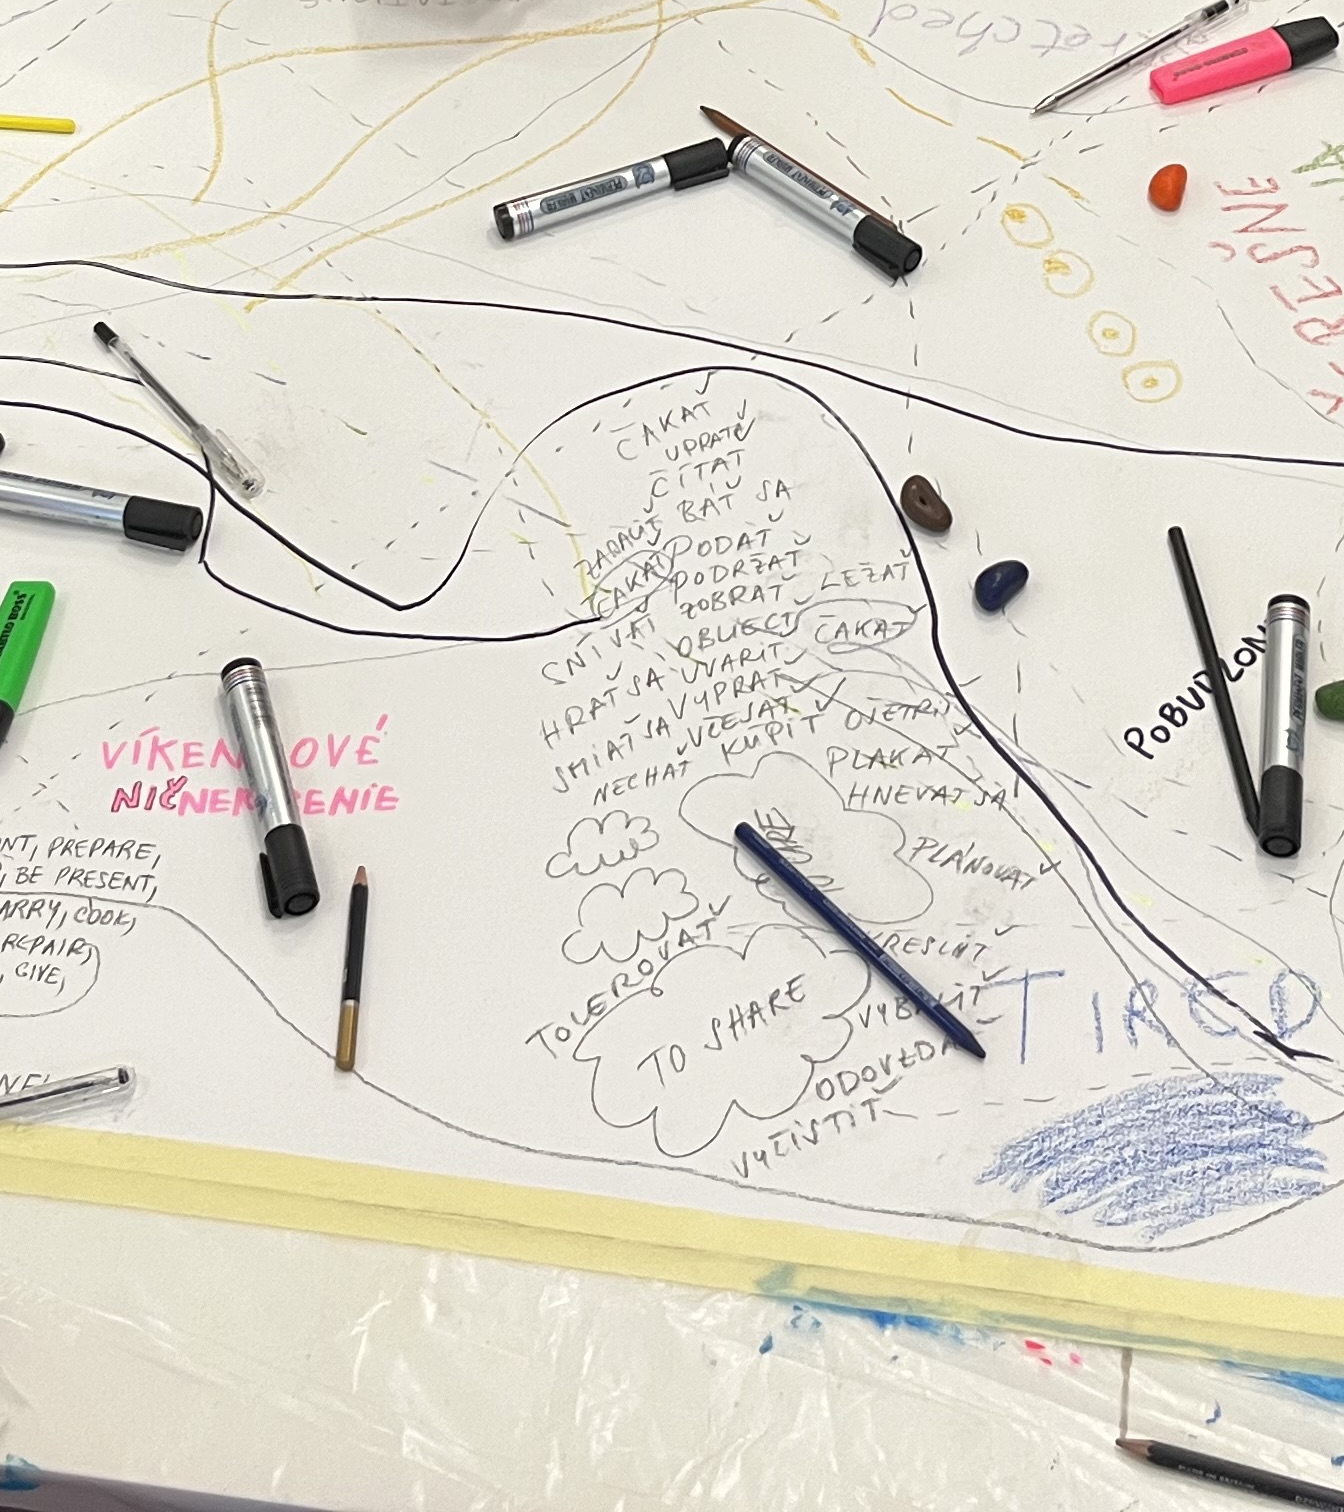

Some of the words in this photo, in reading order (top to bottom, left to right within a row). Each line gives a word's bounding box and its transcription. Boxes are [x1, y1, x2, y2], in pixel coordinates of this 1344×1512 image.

[102, 712, 390, 773] VÍKENOVÉ
[47, 836, 162, 871] PREPARE,
[15, 865, 44, 885] BE
[53, 865, 158, 908] PRESENT,
[636, 1043, 687, 1088] TO
[703, 973, 807, 1051] SHARE
